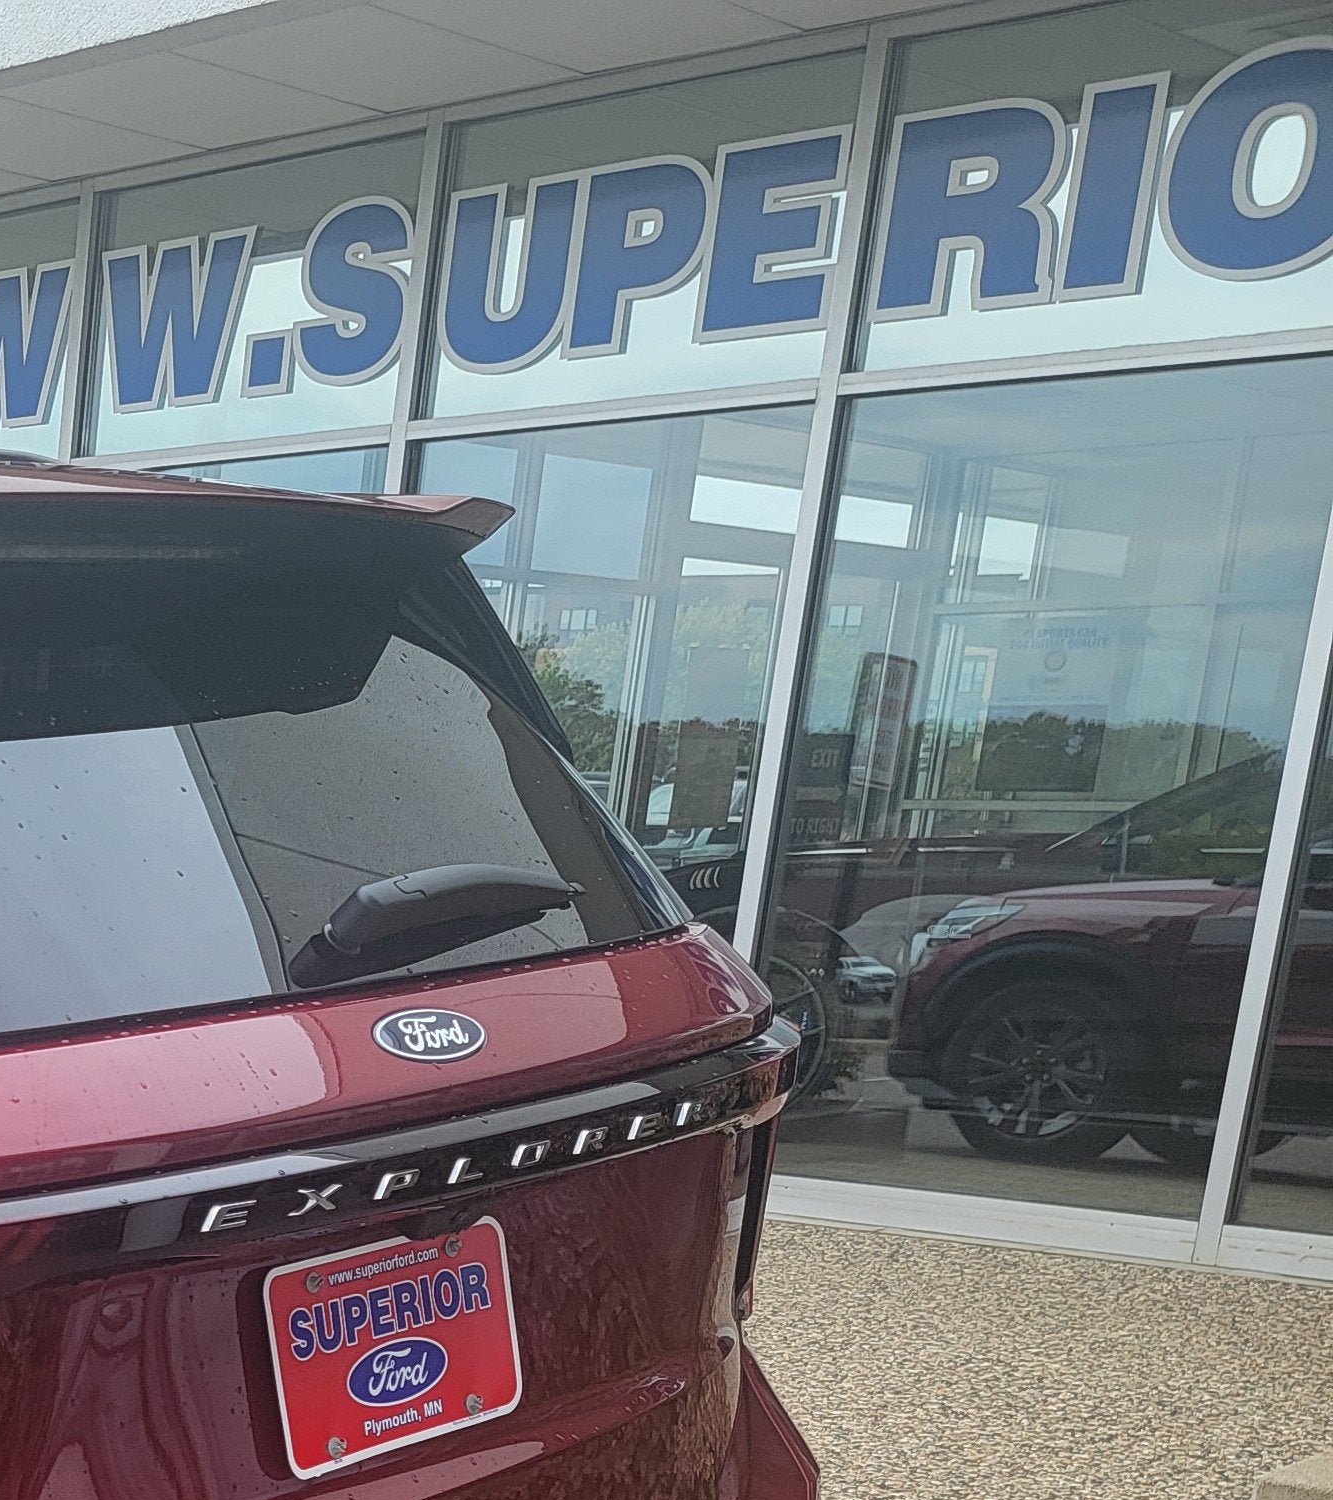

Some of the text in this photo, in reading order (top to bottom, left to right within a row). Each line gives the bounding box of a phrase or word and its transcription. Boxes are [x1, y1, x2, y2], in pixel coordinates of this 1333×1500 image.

[1037, 627, 1075, 638] SPORTS
[1077, 627, 1097, 638] CAR
[1068, 637, 1109, 649] QUALITY
[810, 748, 840, 768] EXIT
[789, 818, 840, 835] TO RIGHT
[199, 1101, 710, 1234] EXPLORER
[328, 1246, 439, 1286] www.superiorford.com
[289, 1262, 492, 1361] SUPERIOR
[368, 1347, 429, 1397] Ford
[363, 1408, 422, 1437] Plymouth,
[424, 1399, 443, 1418] MN
